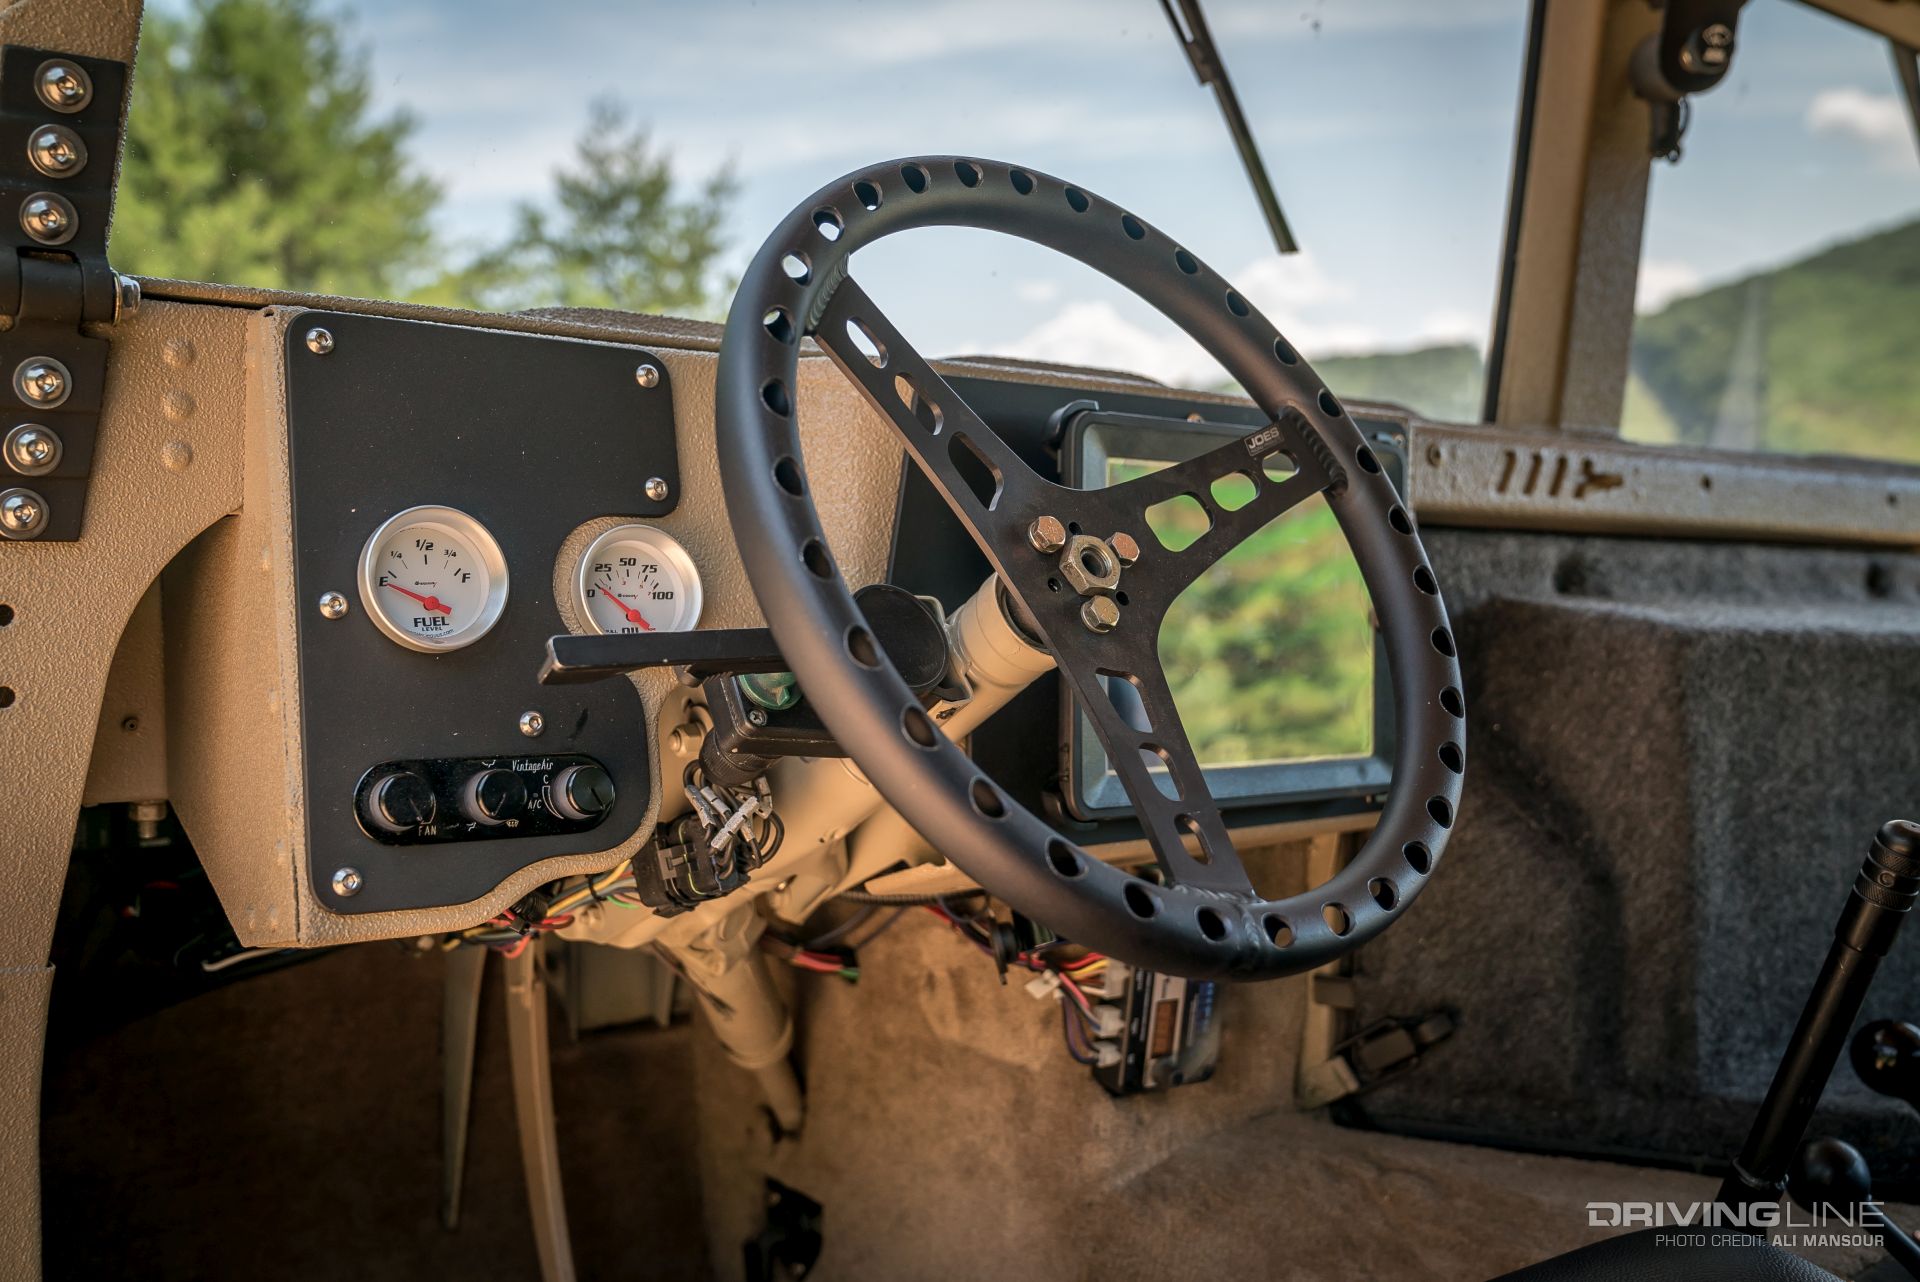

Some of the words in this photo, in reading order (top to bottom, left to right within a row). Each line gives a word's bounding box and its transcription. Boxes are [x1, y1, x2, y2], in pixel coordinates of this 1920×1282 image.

[1248, 427, 1280, 449] JOES
[415, 539, 434, 551] 1/2
[390, 550, 402, 559] 1/4
[444, 549, 457, 558] 3/4
[619, 557, 637, 566] 50
[594, 563, 612, 573] 25
[641, 564, 658, 573] 75
[378, 576, 389, 587] E
[461, 573, 471, 583] F
[586, 589, 596, 598] 0
[652, 591, 674, 600] 100
[413, 616, 450, 627] FUEL
[543, 775, 550, 785] C
[527, 798, 542, 811] A/C
[418, 824, 438, 837] FAN
